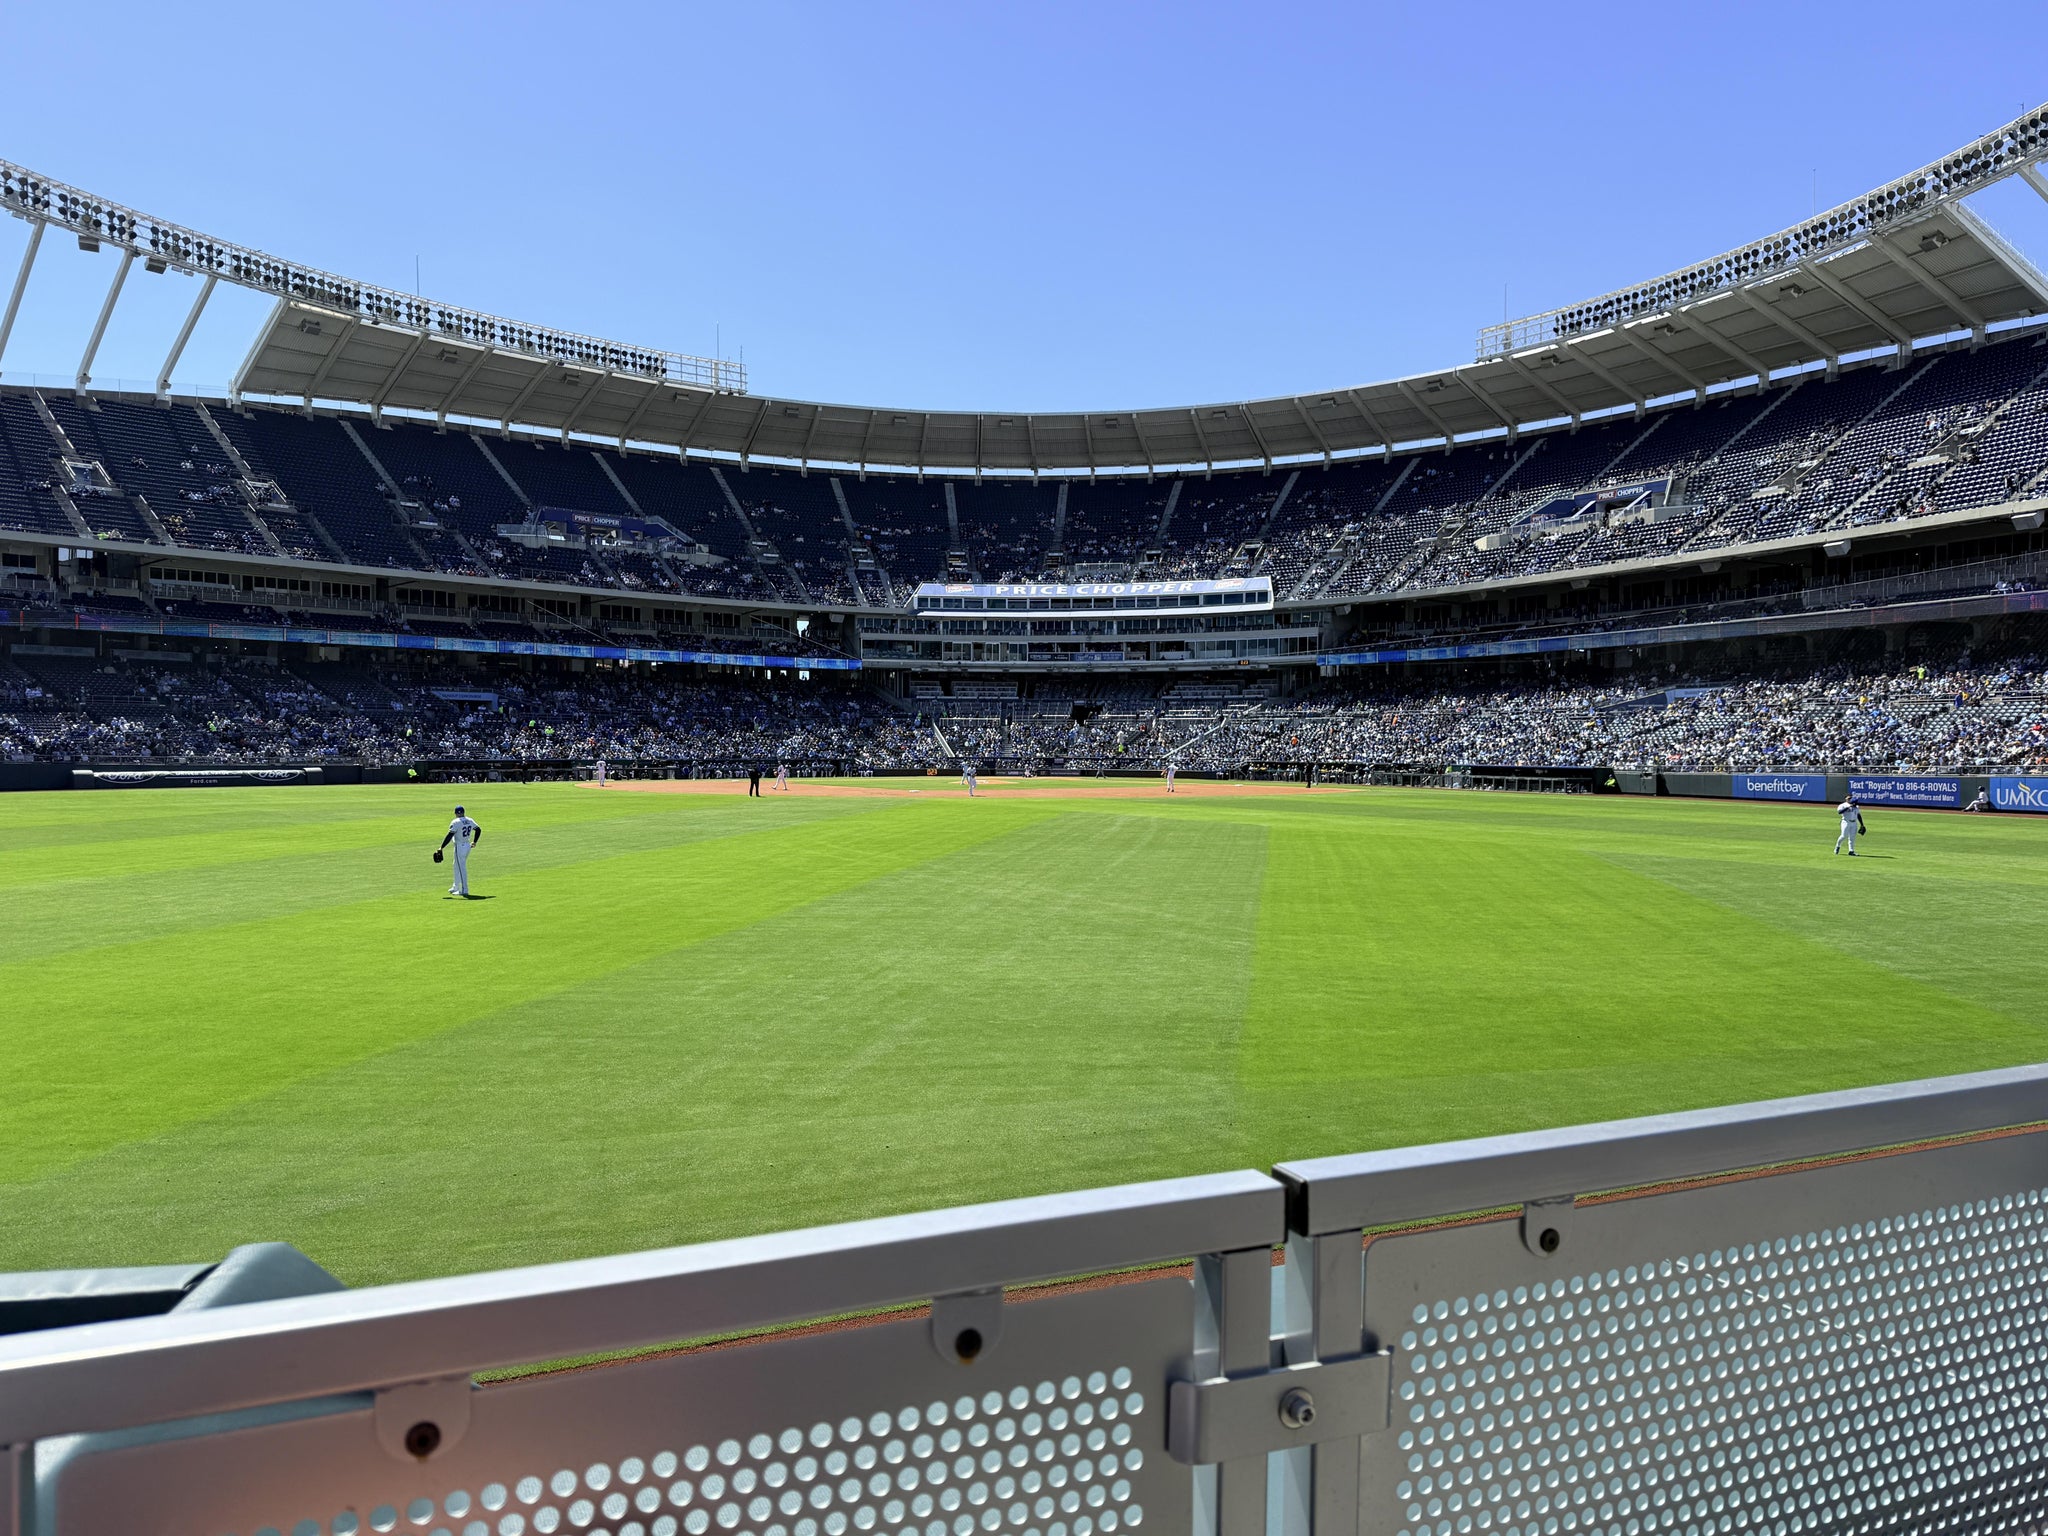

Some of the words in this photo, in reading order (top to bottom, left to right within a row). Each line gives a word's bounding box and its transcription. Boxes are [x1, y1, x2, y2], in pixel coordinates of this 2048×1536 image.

[1598, 491, 1615, 500] PRICE
[1617, 487, 1644, 496] CHOPPER
[574, 514, 590, 522] PRICE
[593, 517, 620, 526] CHOPPER
[995, 586, 1068, 595] PRICE
[1076, 582, 1194, 595] CHOPPER
[1747, 778, 1805, 796] benefitbay
[1849, 780, 1864, 790] Text
[1896, 782, 1904, 791] to
[1905, 781, 1957, 792] 816-6-ROYALS
